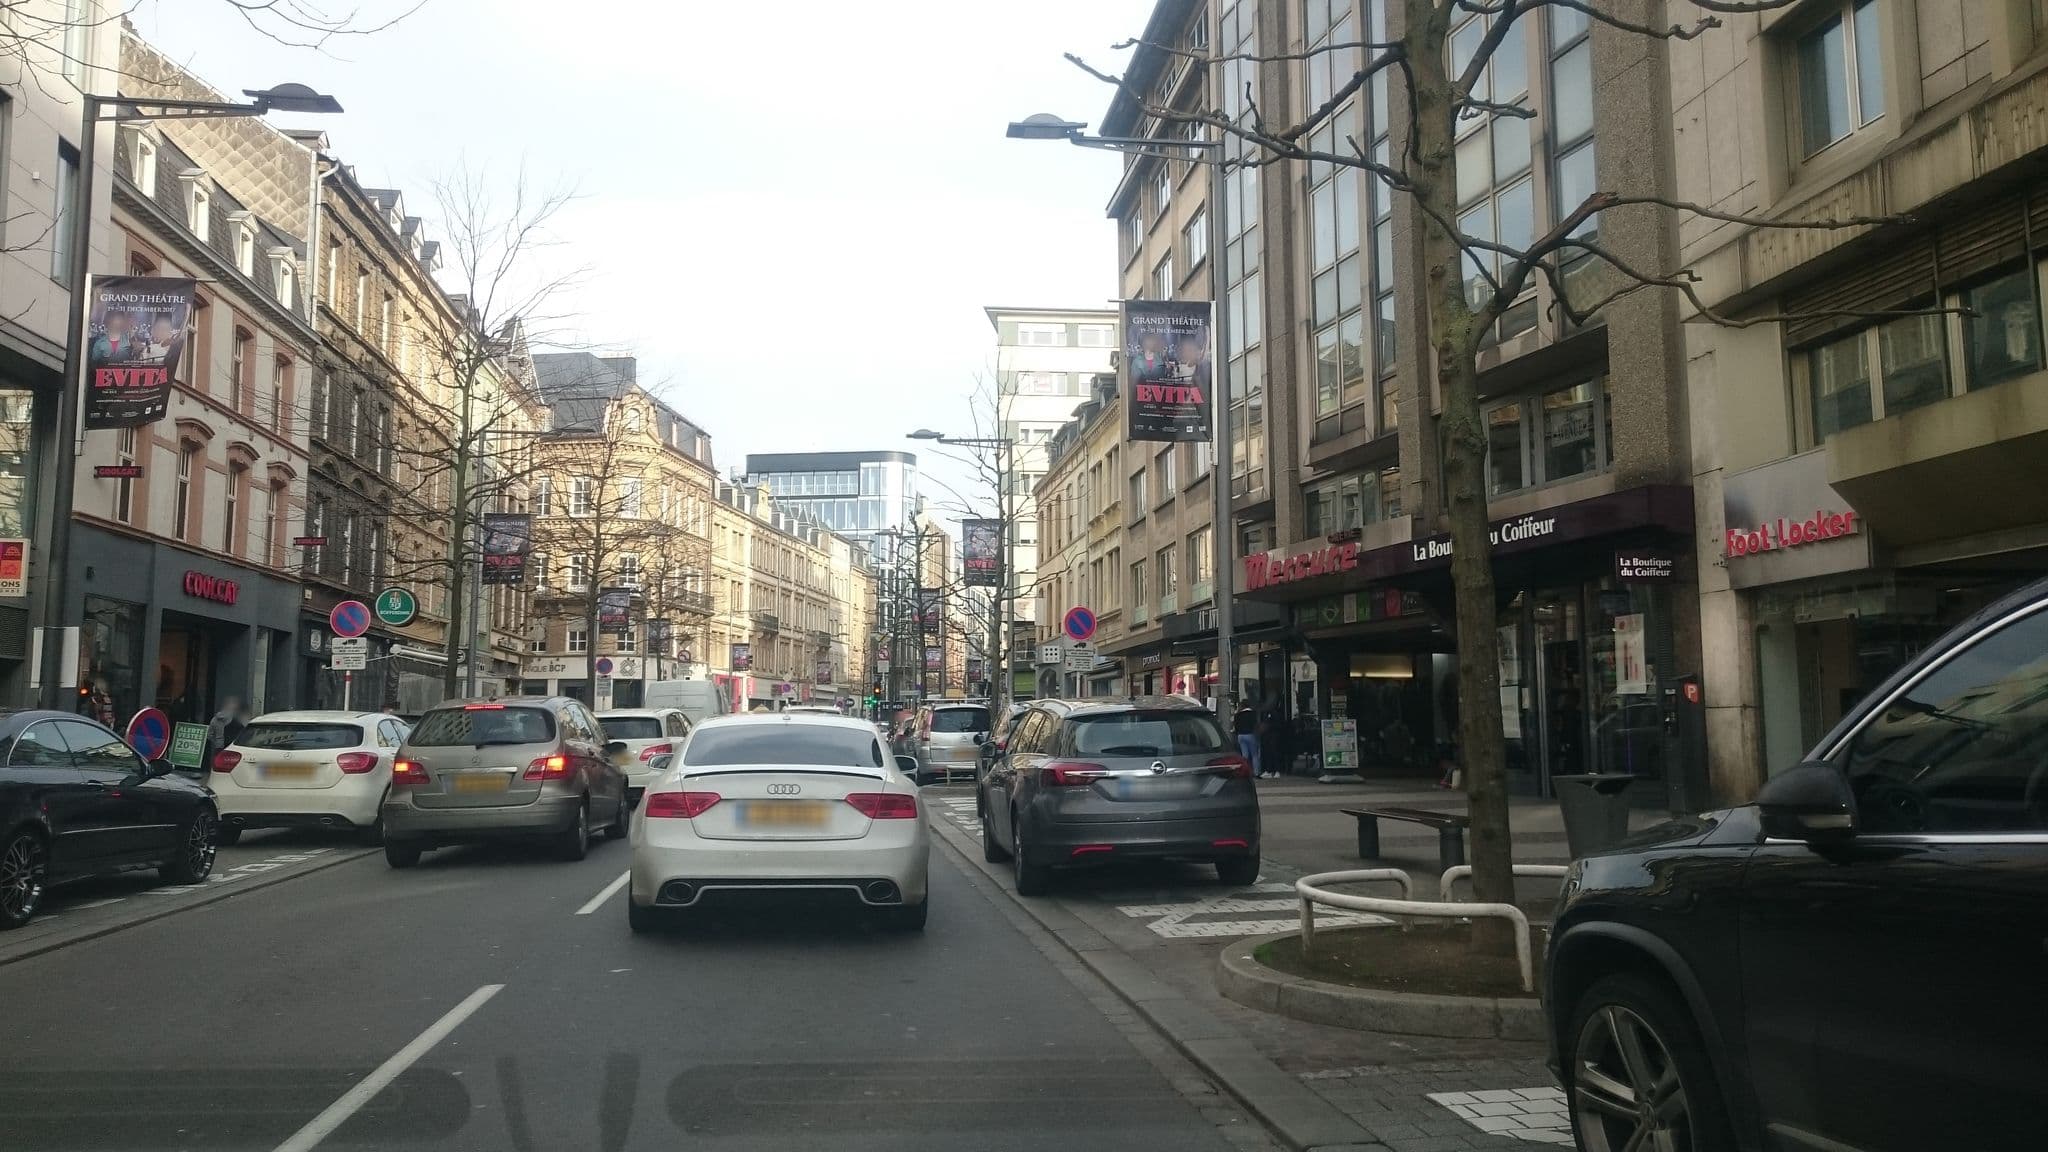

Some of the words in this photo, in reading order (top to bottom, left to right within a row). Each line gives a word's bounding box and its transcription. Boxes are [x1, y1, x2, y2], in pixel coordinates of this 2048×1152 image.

[100, 294, 138, 302] GRAND
[1132, 316, 1165, 325] GRAND
[95, 368, 168, 387] EVITA
[1136, 385, 1204, 404] EVITA
[1413, 544, 1427, 562] La
[1502, 516, 1556, 543] Coiffeur
[1727, 523, 1771, 557] Foot
[1777, 510, 1855, 548] Locker
[1245, 543, 1359, 591] Mercure
[1620, 557, 1631, 567] La
[1632, 557, 1672, 569] Boutique
[1620, 567, 1633, 577] du
[1634, 567, 1672, 577] Coiffeur
[185, 570, 238, 605] COOLCAT
[1687, 686, 1697, 699] P
